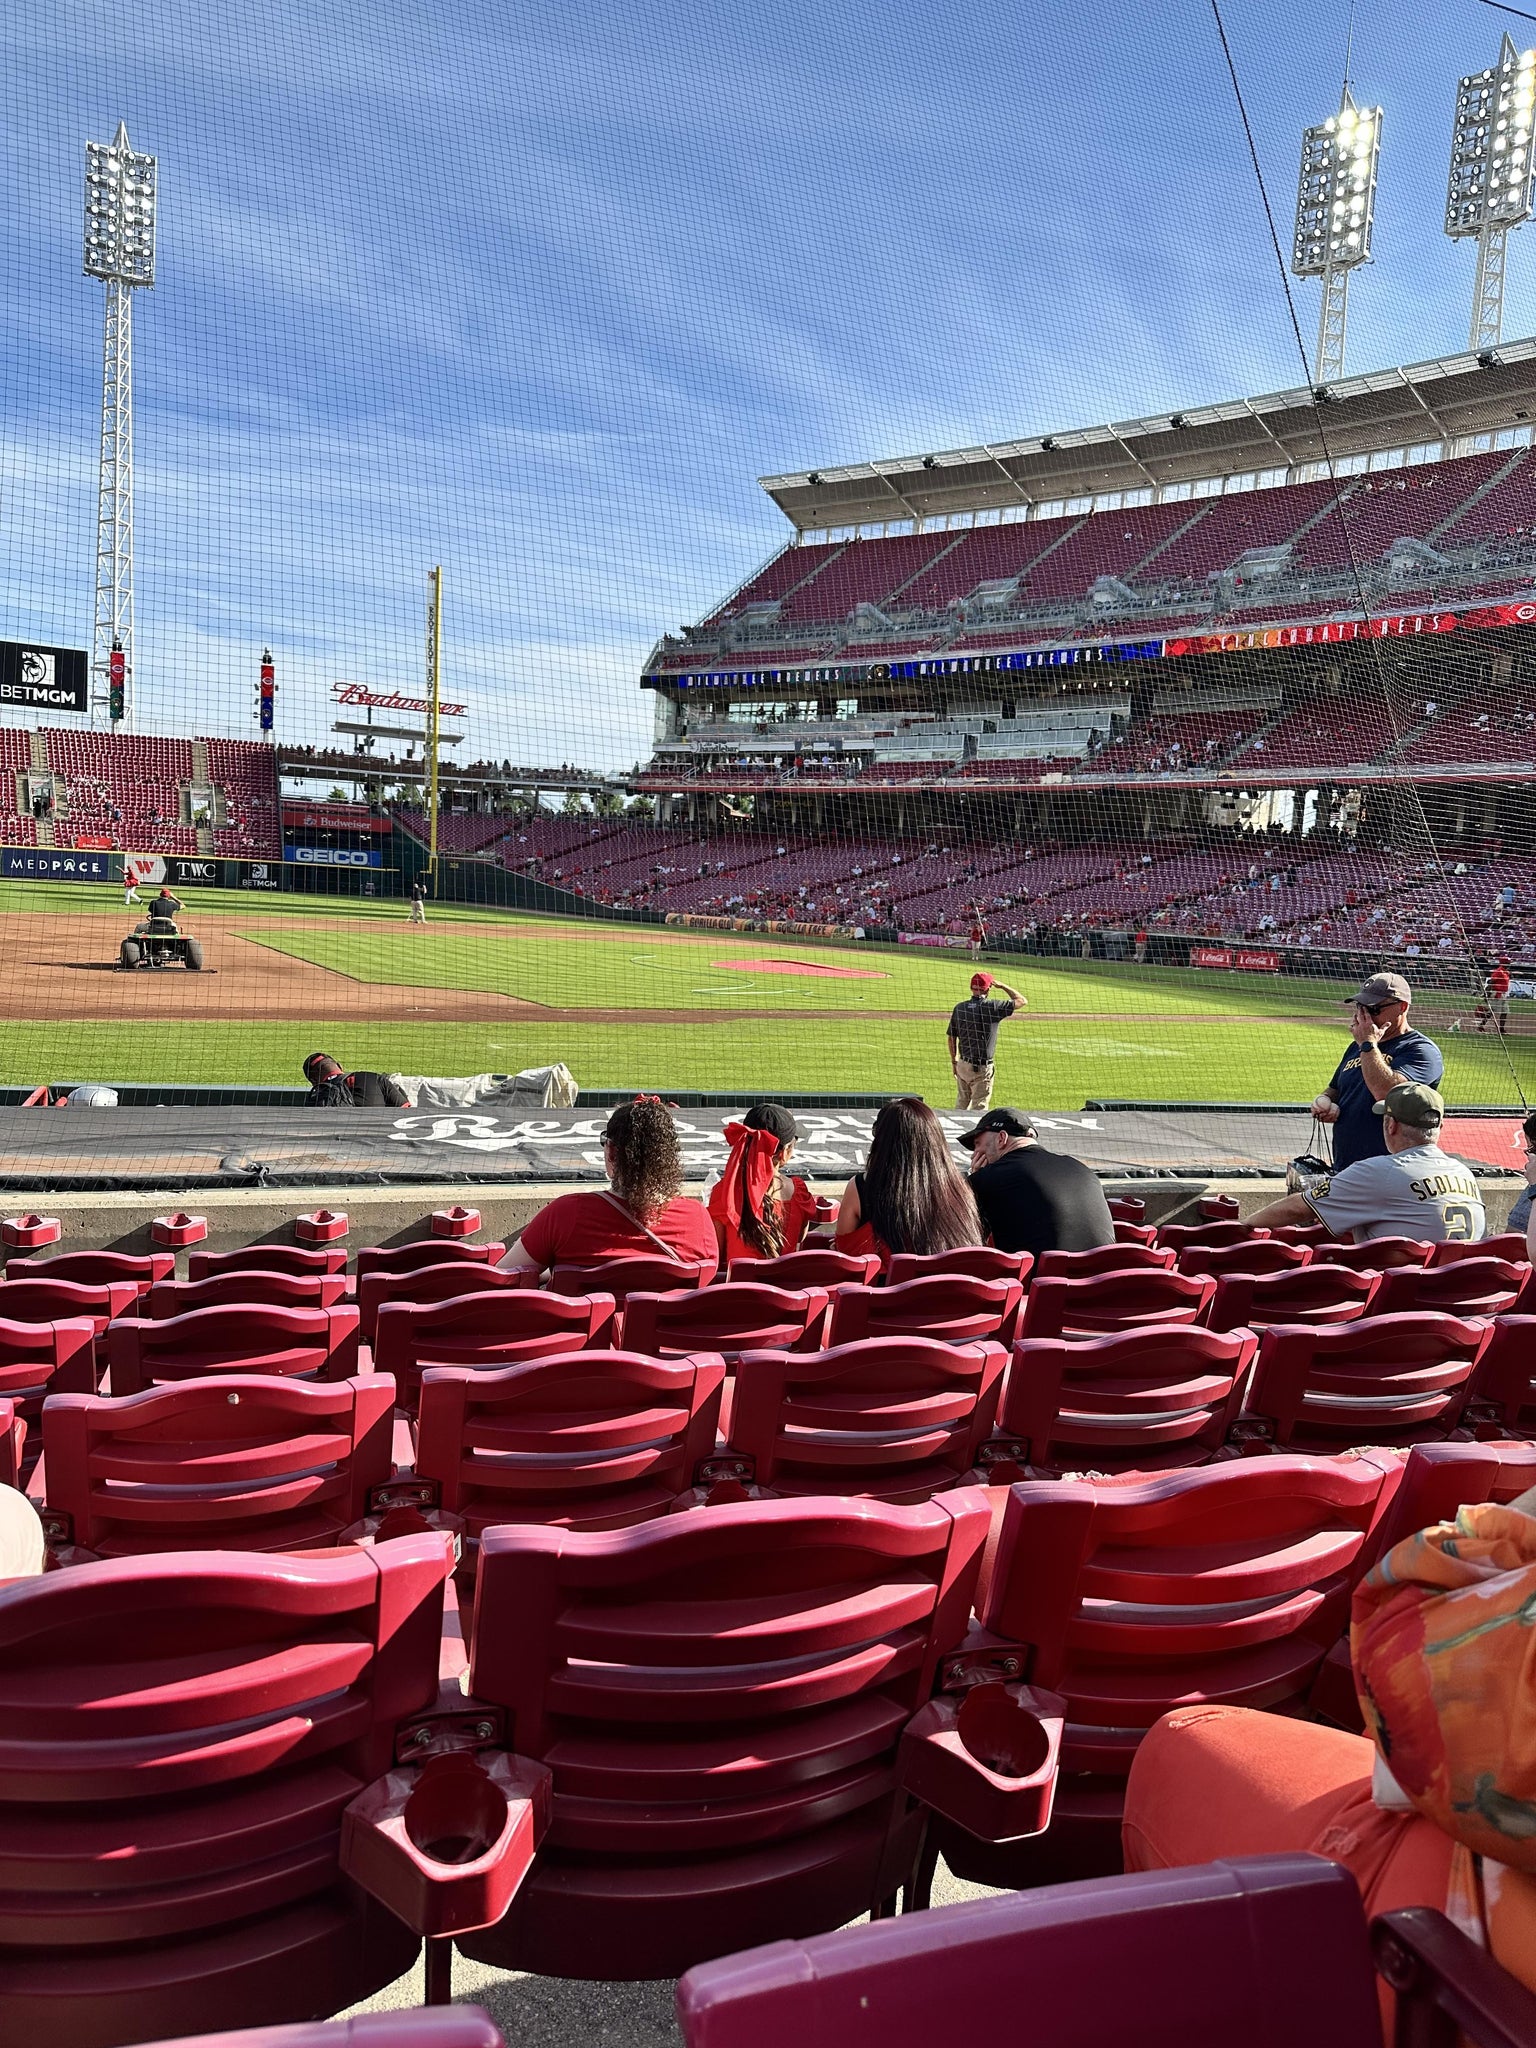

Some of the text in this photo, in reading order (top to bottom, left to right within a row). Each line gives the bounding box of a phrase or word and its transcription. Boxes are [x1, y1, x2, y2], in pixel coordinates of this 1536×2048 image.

[1221, 615, 1439, 650] CINCINNATI REDS
[1026, 649, 1103, 666] BREWERS
[0, 684, 76, 704] BETMGM
[334, 682, 464, 715] Budweier
[320, 817, 372, 829] Budweiser
[295, 848, 369, 865] GEICO
[176, 862, 216, 878] TWC
[242, 879, 278, 888] BETMGM
[689, 917, 734, 930] GORILLA GLU
[776, 923, 806, 935] GOLLA
